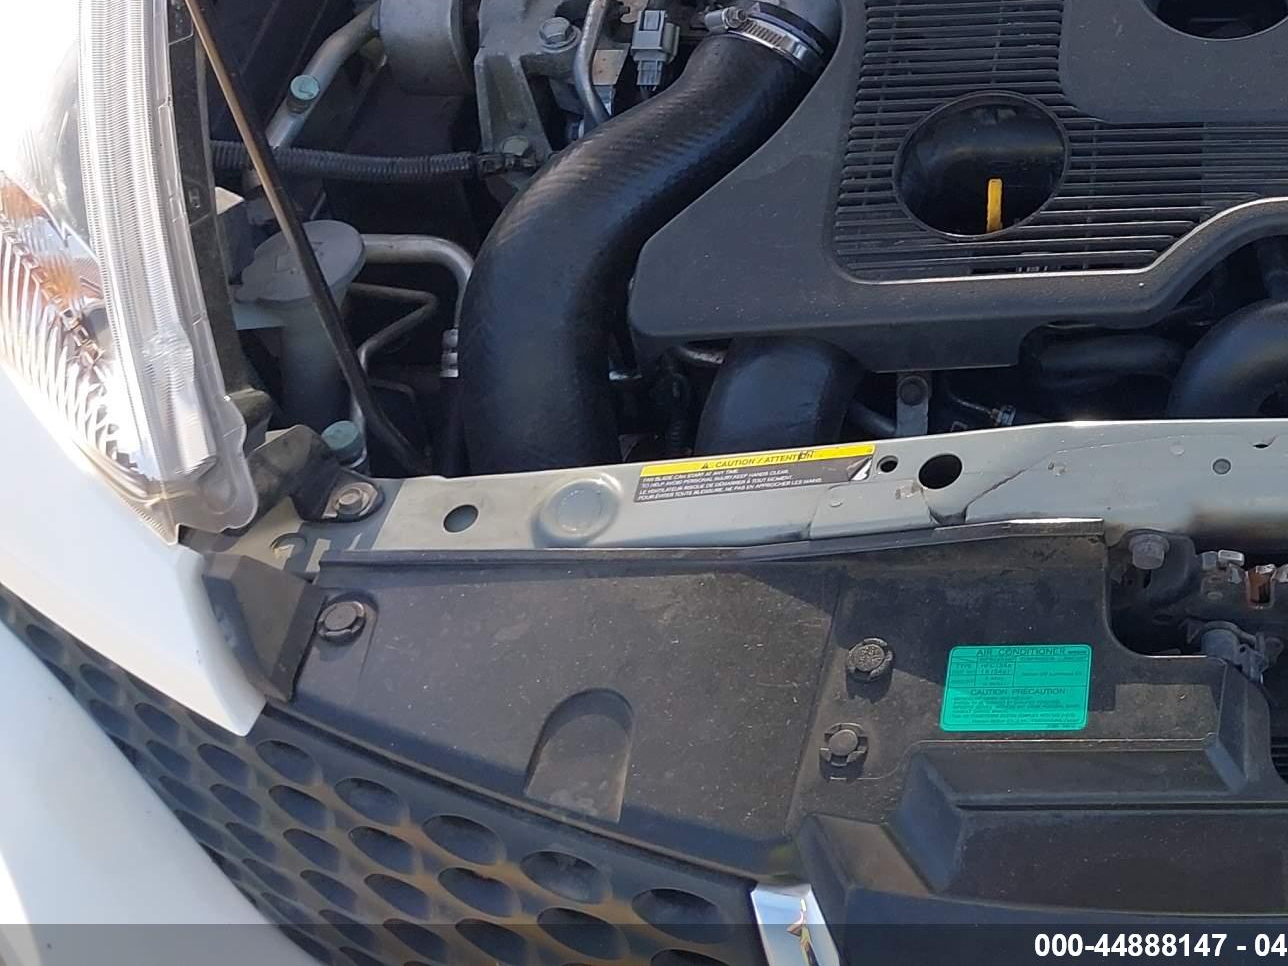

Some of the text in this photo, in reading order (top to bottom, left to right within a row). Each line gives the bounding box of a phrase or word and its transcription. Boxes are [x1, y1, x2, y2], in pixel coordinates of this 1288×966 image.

[715, 458, 755, 468] CAUTION
[976, 648, 993, 656] AIR
[998, 647, 1066, 656] CONDITIONER
[970, 687, 1066, 696] CAUTION PRECAUTION
